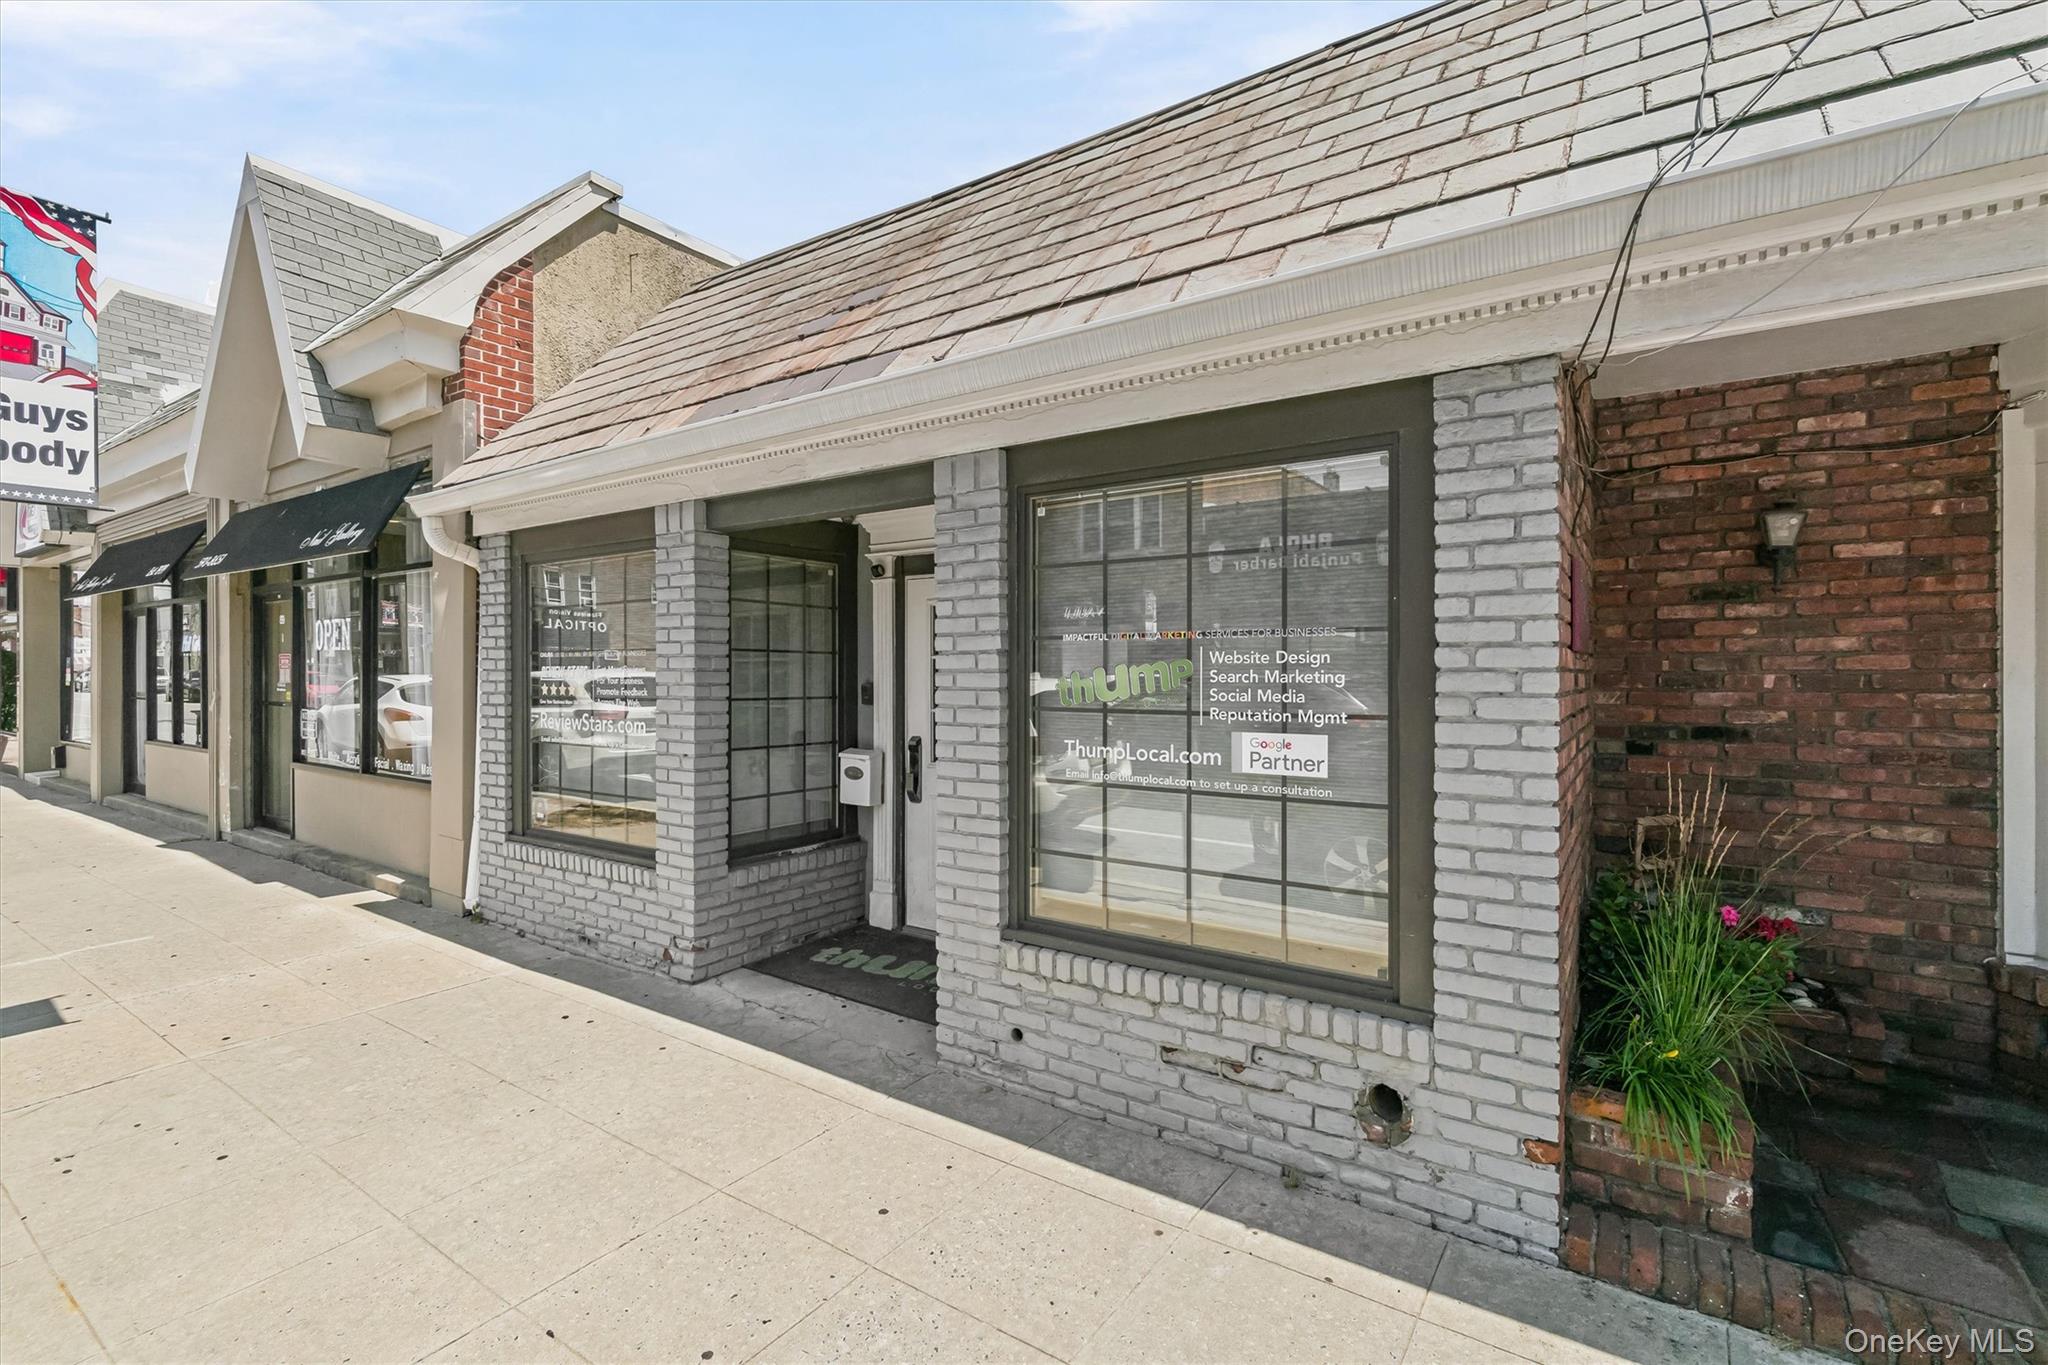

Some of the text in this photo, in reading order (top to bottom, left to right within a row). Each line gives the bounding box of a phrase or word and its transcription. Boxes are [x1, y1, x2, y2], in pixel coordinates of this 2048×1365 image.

[315, 617, 352, 651] OPEN
[1063, 632, 1109, 642] IMPACTFUL
[1205, 628, 1249, 639] SERVICES
[1252, 628, 1272, 638] FOR
[1275, 626, 1337, 638] BUSINESSES
[1209, 650, 1331, 668] Website Design
[1209, 669, 1346, 688] Search Marketing
[596, 687, 648, 697] Promote Feedback
[1209, 687, 1306, 703] Social Media
[540, 711, 647, 734] ReviewStars.com
[1209, 707, 1348, 728] Reputation Mgmt
[1063, 739, 1222, 767] ThumpLocal.com
[1249, 737, 1292, 752] Google
[1249, 751, 1325, 774] Partner
[1065, 768, 1333, 798] Email info@thumplocal.com to set up a consultation
